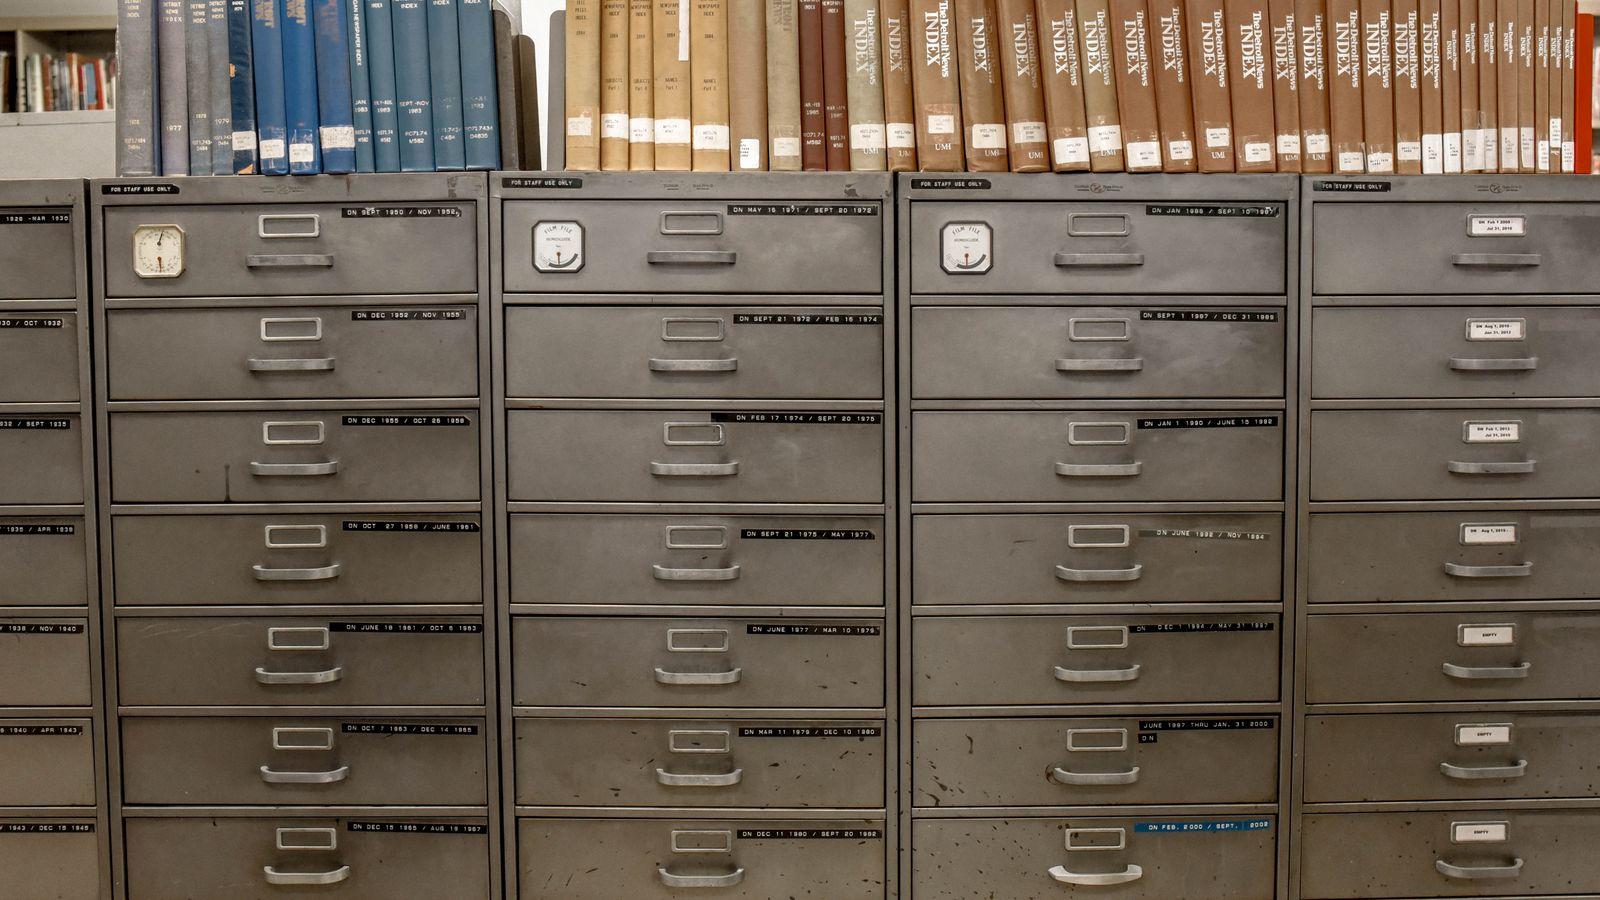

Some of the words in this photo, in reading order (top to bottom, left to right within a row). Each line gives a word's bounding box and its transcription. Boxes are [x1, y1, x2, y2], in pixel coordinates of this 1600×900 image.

[939, 0, 949, 18] The
[1064, 9, 1073, 28] The
[1136, 10, 1144, 28] The
[1172, 6, 1180, 25] The
[1213, 9, 1223, 28] The
[1252, 11, 1262, 29] The
[1286, 13, 1294, 32] The
[1349, 9, 1358, 29] The
[1380, 10, 1389, 30] The
[1408, 10, 1417, 30] The
[854, 19, 869, 72] INDEX
[888, 17, 903, 72] INDEX
[924, 11, 941, 66] INDEX
[940, 18, 950, 52] Detroit
[971, 17, 988, 72] INDEX
[1013, 23, 1030, 77] INDEX
[1051, 19, 1069, 75] INDEX
[1065, 28, 1076, 60] Detroit
[1084, 19, 1102, 74] INDEX
[1124, 19, 1140, 75] INDEX
[1138, 28, 1147, 61] Detroit
[1160, 16, 1176, 71] INDEX
[1174, 24, 1183, 58] Detroit
[1201, 21, 1217, 76] INDEX
[1215, 28, 1225, 61] Detroit
[1240, 24, 1256, 79] INDEX
[1253, 28, 1264, 63] Detroit
[1287, 31, 1296, 65] Detroit
[1335, 21, 1350, 76] INDEX
[1350, 28, 1359, 63] Detroit
[1366, 22, 1381, 77] INDEX
[1380, 29, 1390, 63] Detroit
[1395, 22, 1409, 77] INDEX
[1408, 29, 1418, 63] Detroit
[1423, 22, 1434, 77] INDEX
[941, 52, 951, 78] News
[1274, 26, 1289, 80] INDEX
[1302, 26, 1318, 79] INDEX
[1069, 61, 1078, 86] News
[1140, 61, 1149, 87] News
[1217, 61, 1226, 88] News
[1256, 62, 1265, 89] News
[1289, 65, 1297, 91] News
[1351, 62, 1360, 88] News
[1382, 63, 1391, 89] News
[1409, 63, 1418, 89] News
[361, 208, 381, 216] SEPT
[1170, 529, 1190, 537] JUNE
